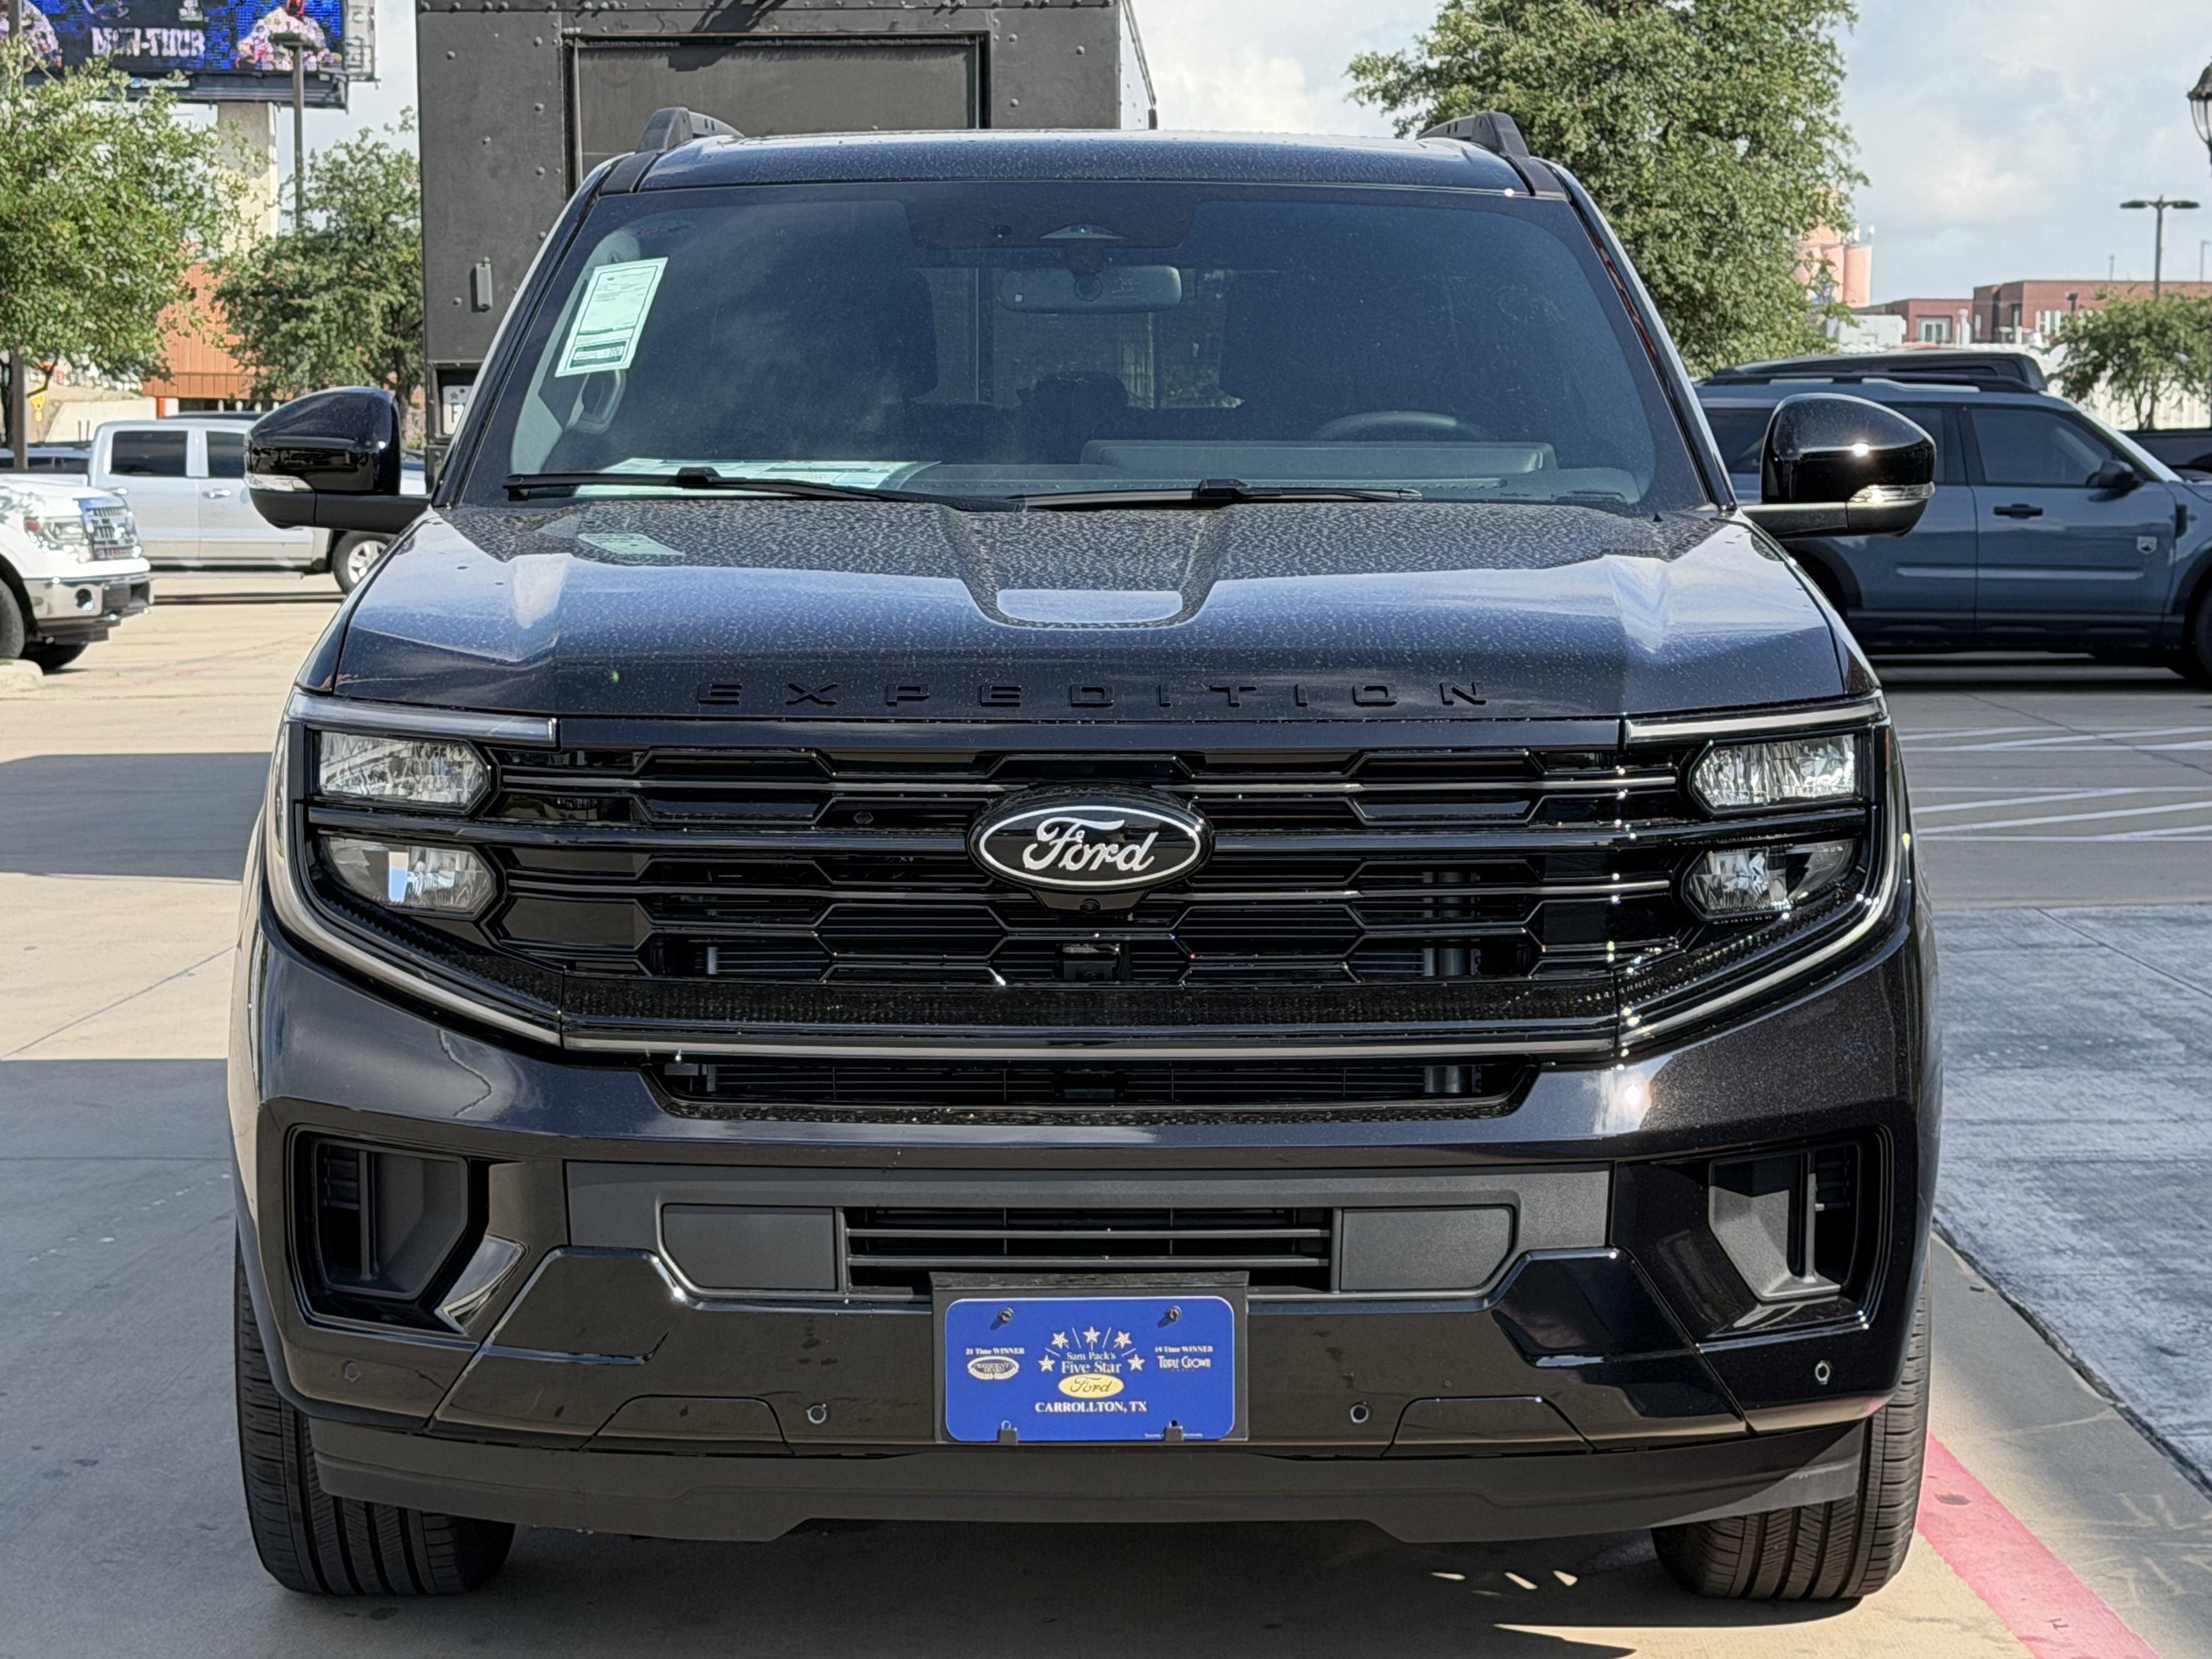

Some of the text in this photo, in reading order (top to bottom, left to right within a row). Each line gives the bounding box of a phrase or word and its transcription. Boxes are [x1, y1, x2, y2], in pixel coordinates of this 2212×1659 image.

[697, 682, 1487, 708] EXPEDITION
[1022, 816, 1159, 871] Ford
[1066, 1351, 1116, 1361] Sam Pack's
[1061, 1360, 1122, 1373] Five Star
[1070, 1376, 1113, 1393] Ford
[1035, 1400, 1147, 1413] CARROLLTON, TX
